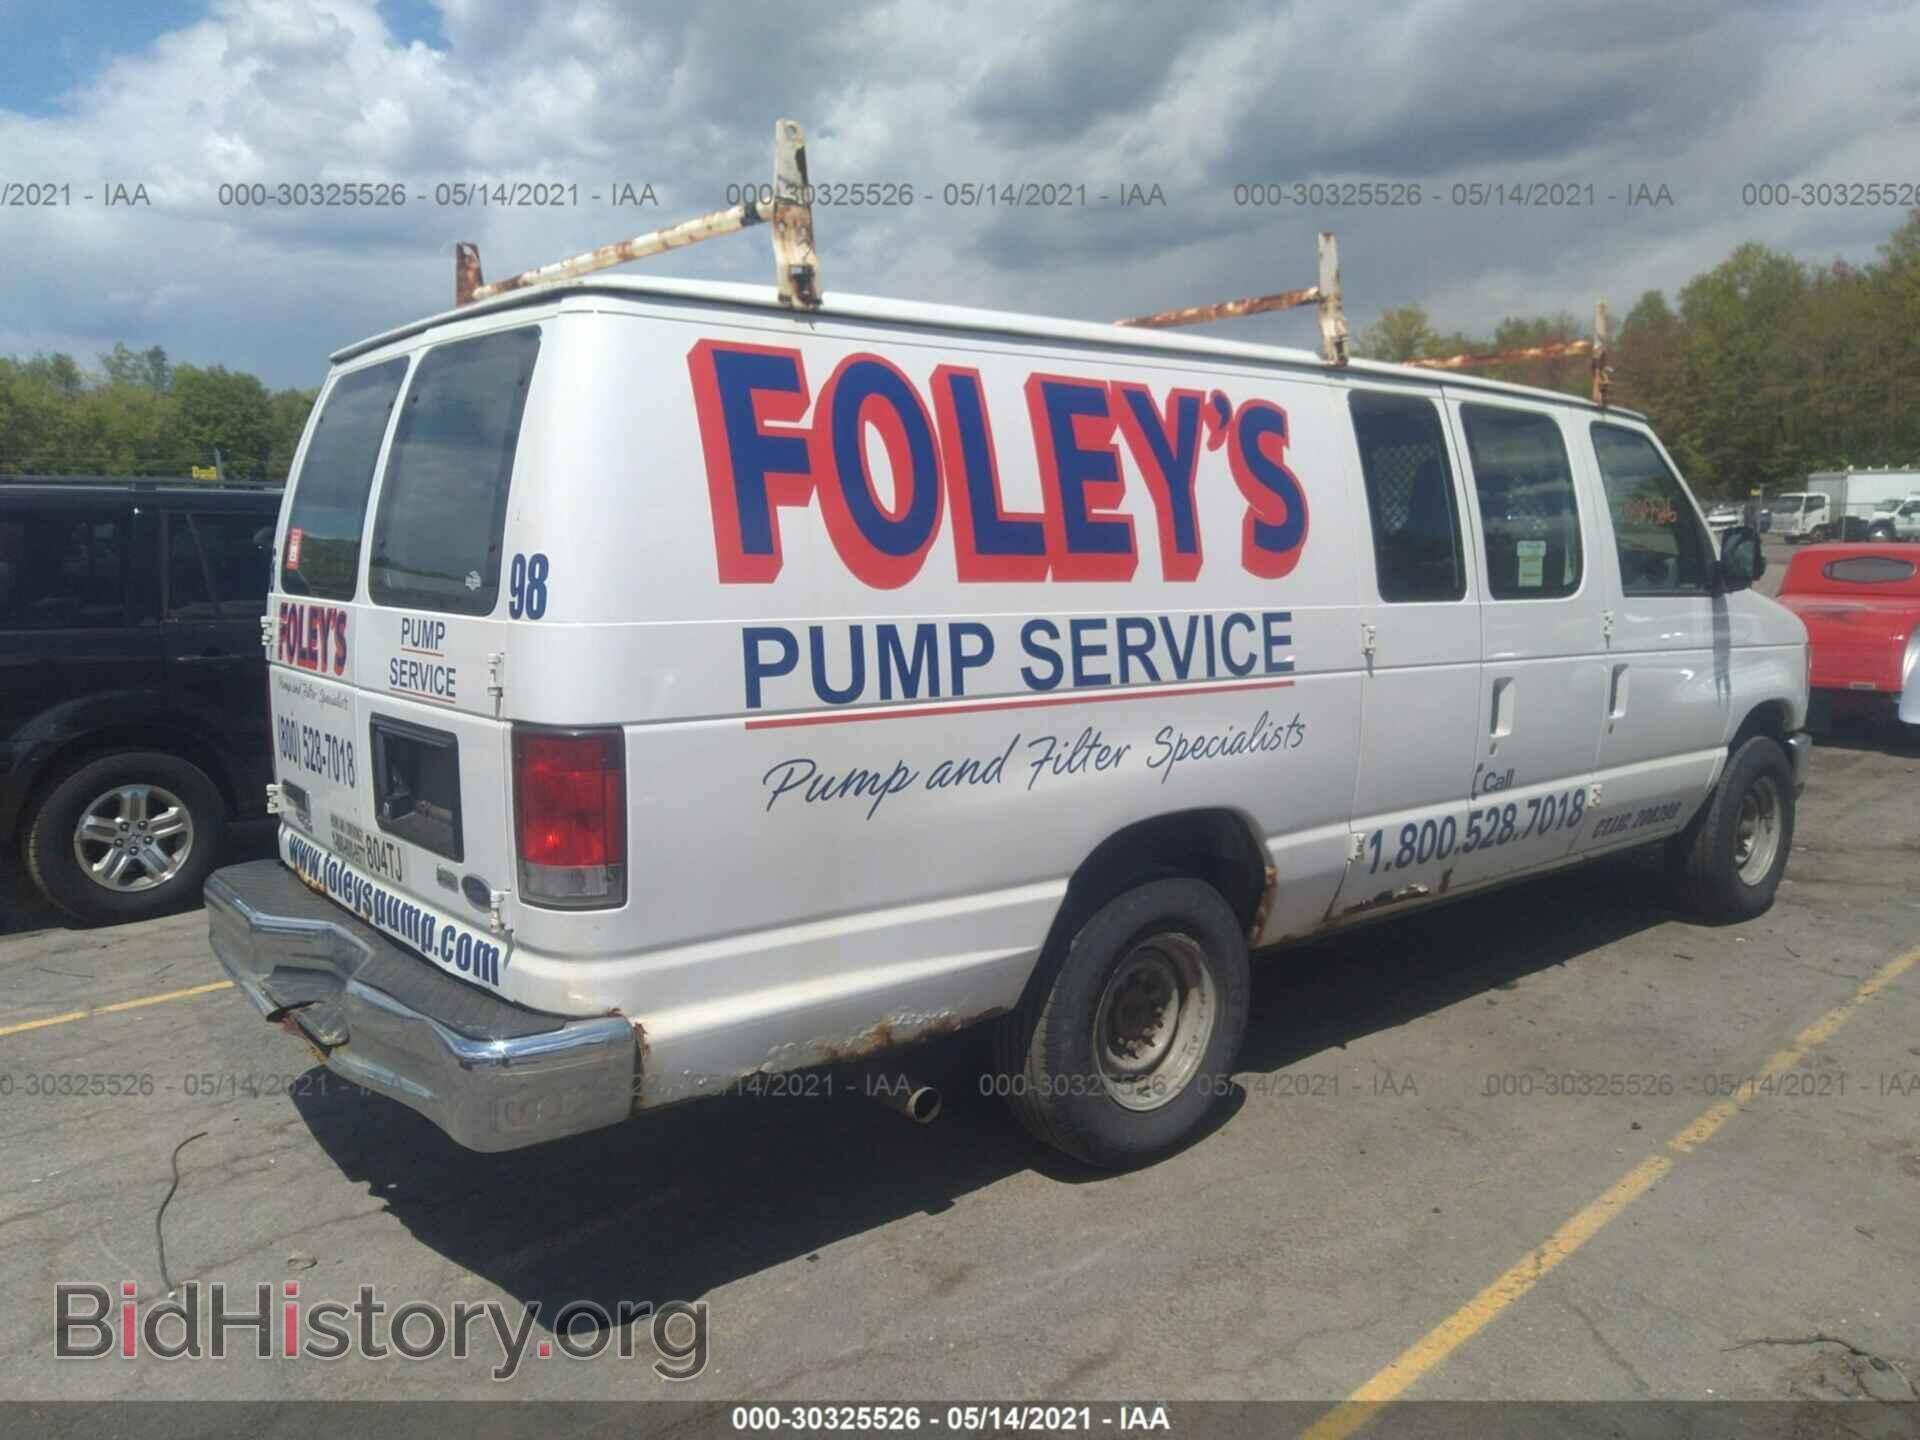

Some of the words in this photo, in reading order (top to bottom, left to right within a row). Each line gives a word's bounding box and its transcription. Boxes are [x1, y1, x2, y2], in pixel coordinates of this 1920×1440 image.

[687, 339, 1309, 590] FOLEY'S
[509, 553, 549, 620] 98
[277, 601, 348, 676] FOLEY'S
[400, 617, 446, 651] PUMP
[741, 619, 995, 709] PUMP
[1019, 611, 1295, 691] SERVICE
[389, 657, 457, 698] SERVICE
[302, 724, 356, 789] 528-7018
[762, 758, 921, 821] Pump
[925, 733, 1020, 790] and
[1027, 727, 1131, 791] Filter
[1146, 710, 1307, 784] Specialists
[1482, 767, 1515, 794] Call
[1368, 788, 1586, 875] 1.800.528.7018
[288, 832, 500, 987] www.foleyspump.com
